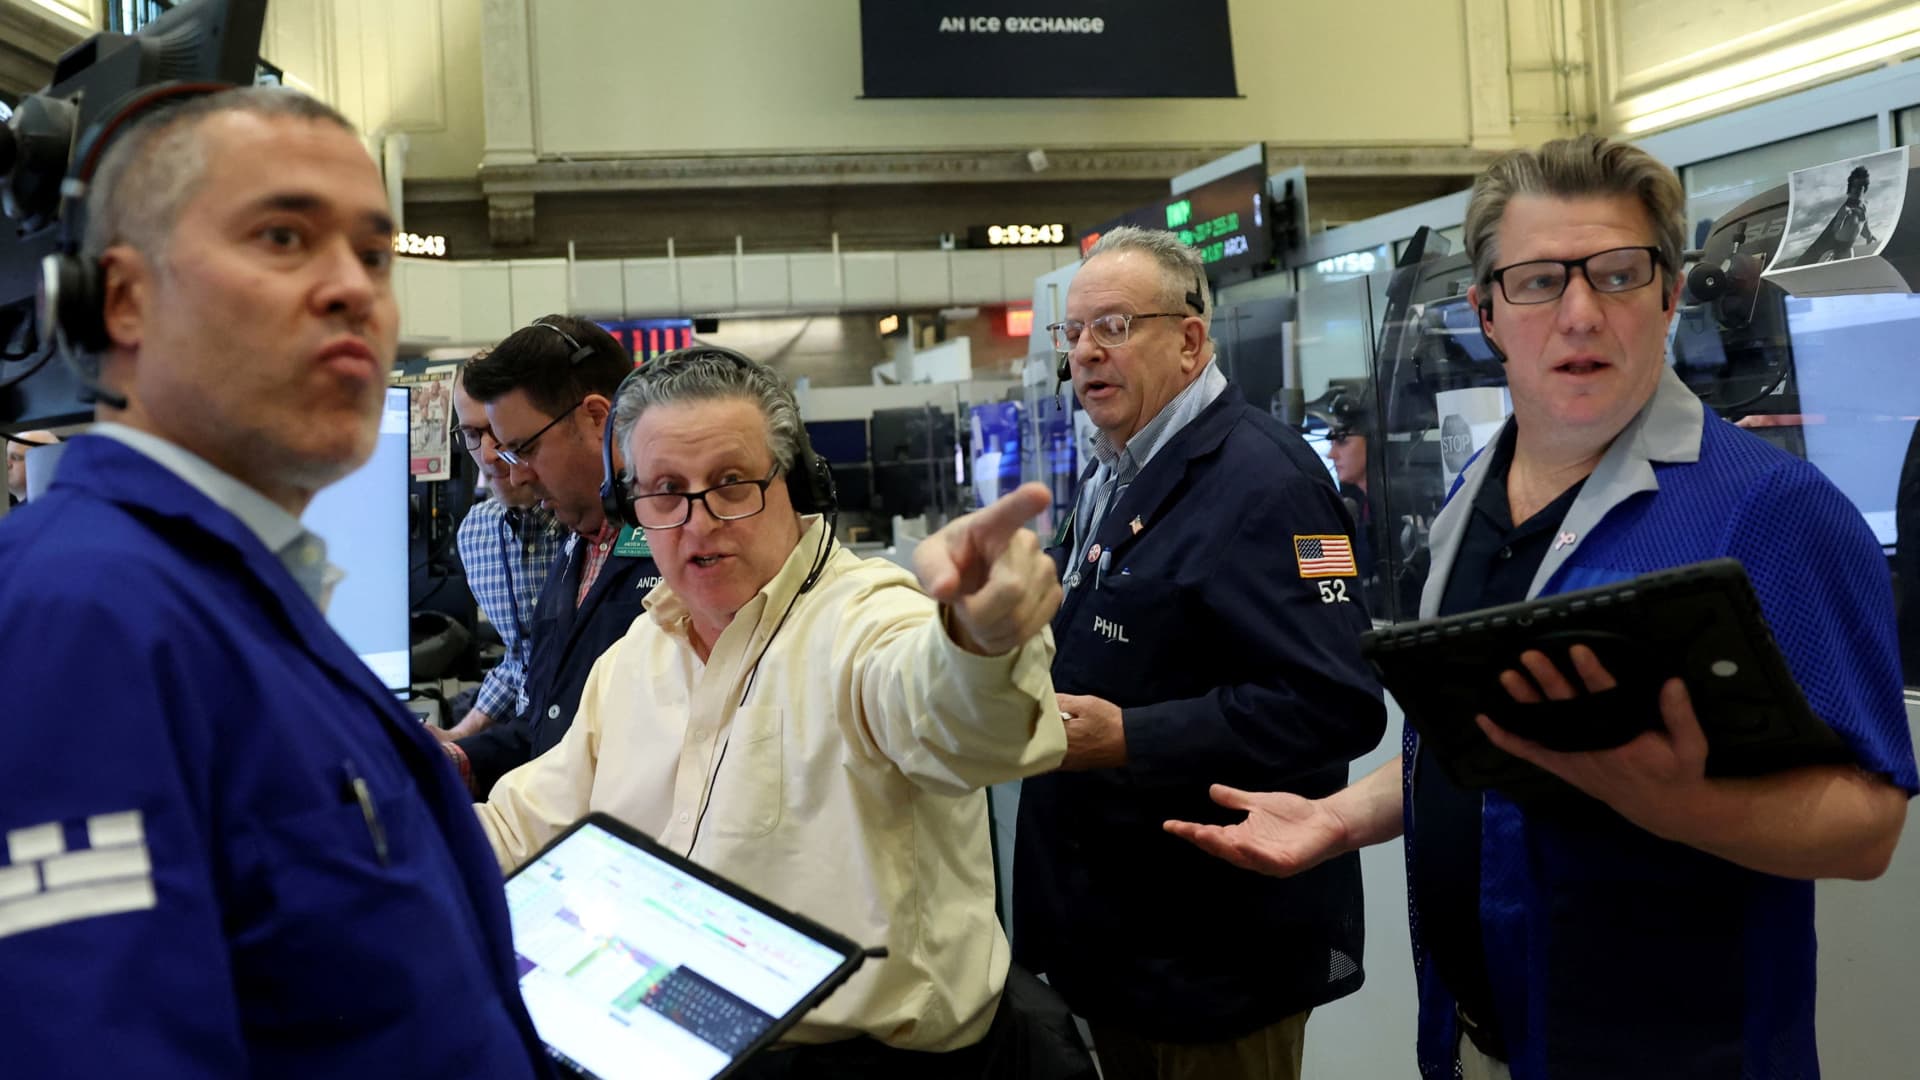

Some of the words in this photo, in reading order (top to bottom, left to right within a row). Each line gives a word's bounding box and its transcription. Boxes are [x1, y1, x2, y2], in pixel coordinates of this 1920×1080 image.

[939, 16, 965, 32] AN
[392, 232, 446, 256] :52:43
[988, 224, 1064, 245] 9:52:43
[1442, 433, 1470, 453] STOP
[1318, 579, 1350, 604] 52
[1093, 615, 1129, 643] PHIL
